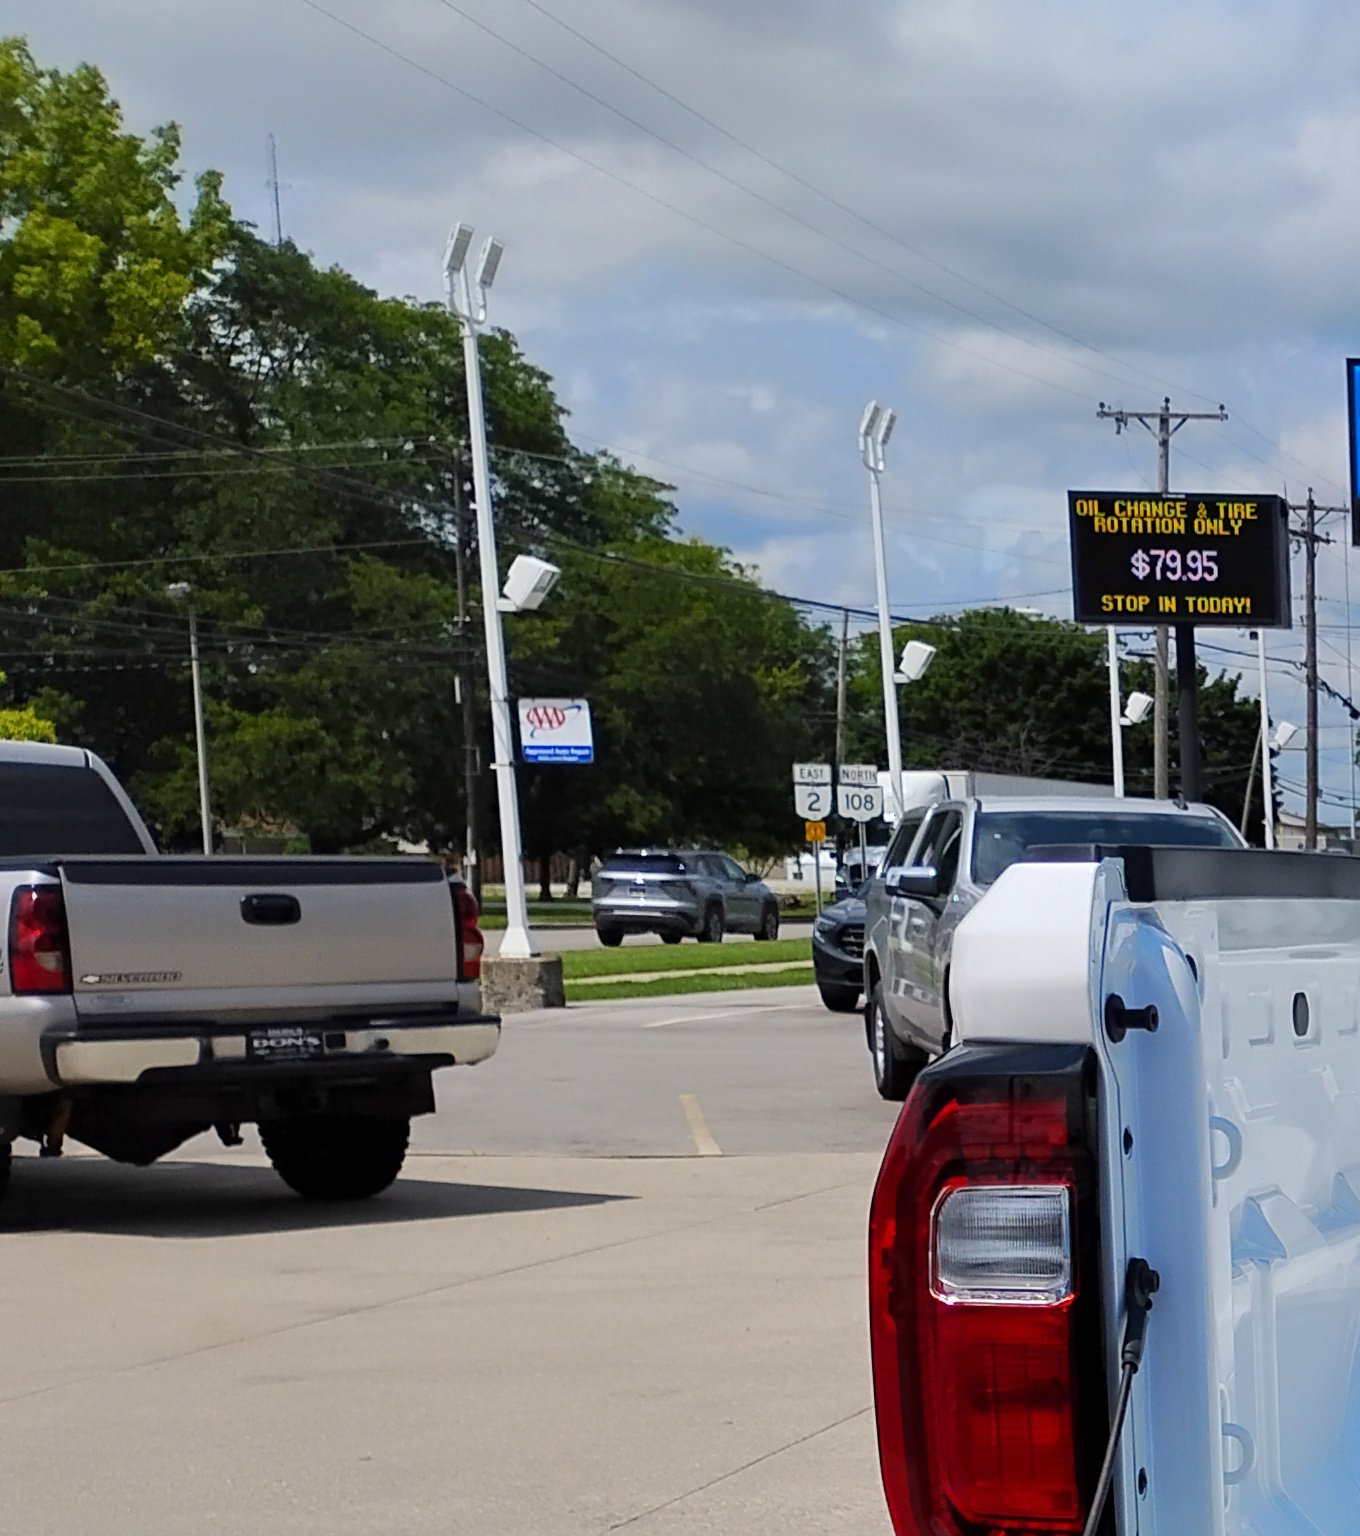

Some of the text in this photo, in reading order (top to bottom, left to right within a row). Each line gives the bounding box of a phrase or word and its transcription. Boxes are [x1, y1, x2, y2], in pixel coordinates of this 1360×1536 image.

[1076, 499, 1258, 519] OIL CHANGE & TIRE
[1094, 517, 1243, 535] ROTATION ONLY
[1131, 549, 1218, 581] $79.95
[1101, 595, 1251, 614] STOP IN TODAY!
[800, 768, 877, 780] EAST NORTH
[807, 792, 875, 812] 2 108
